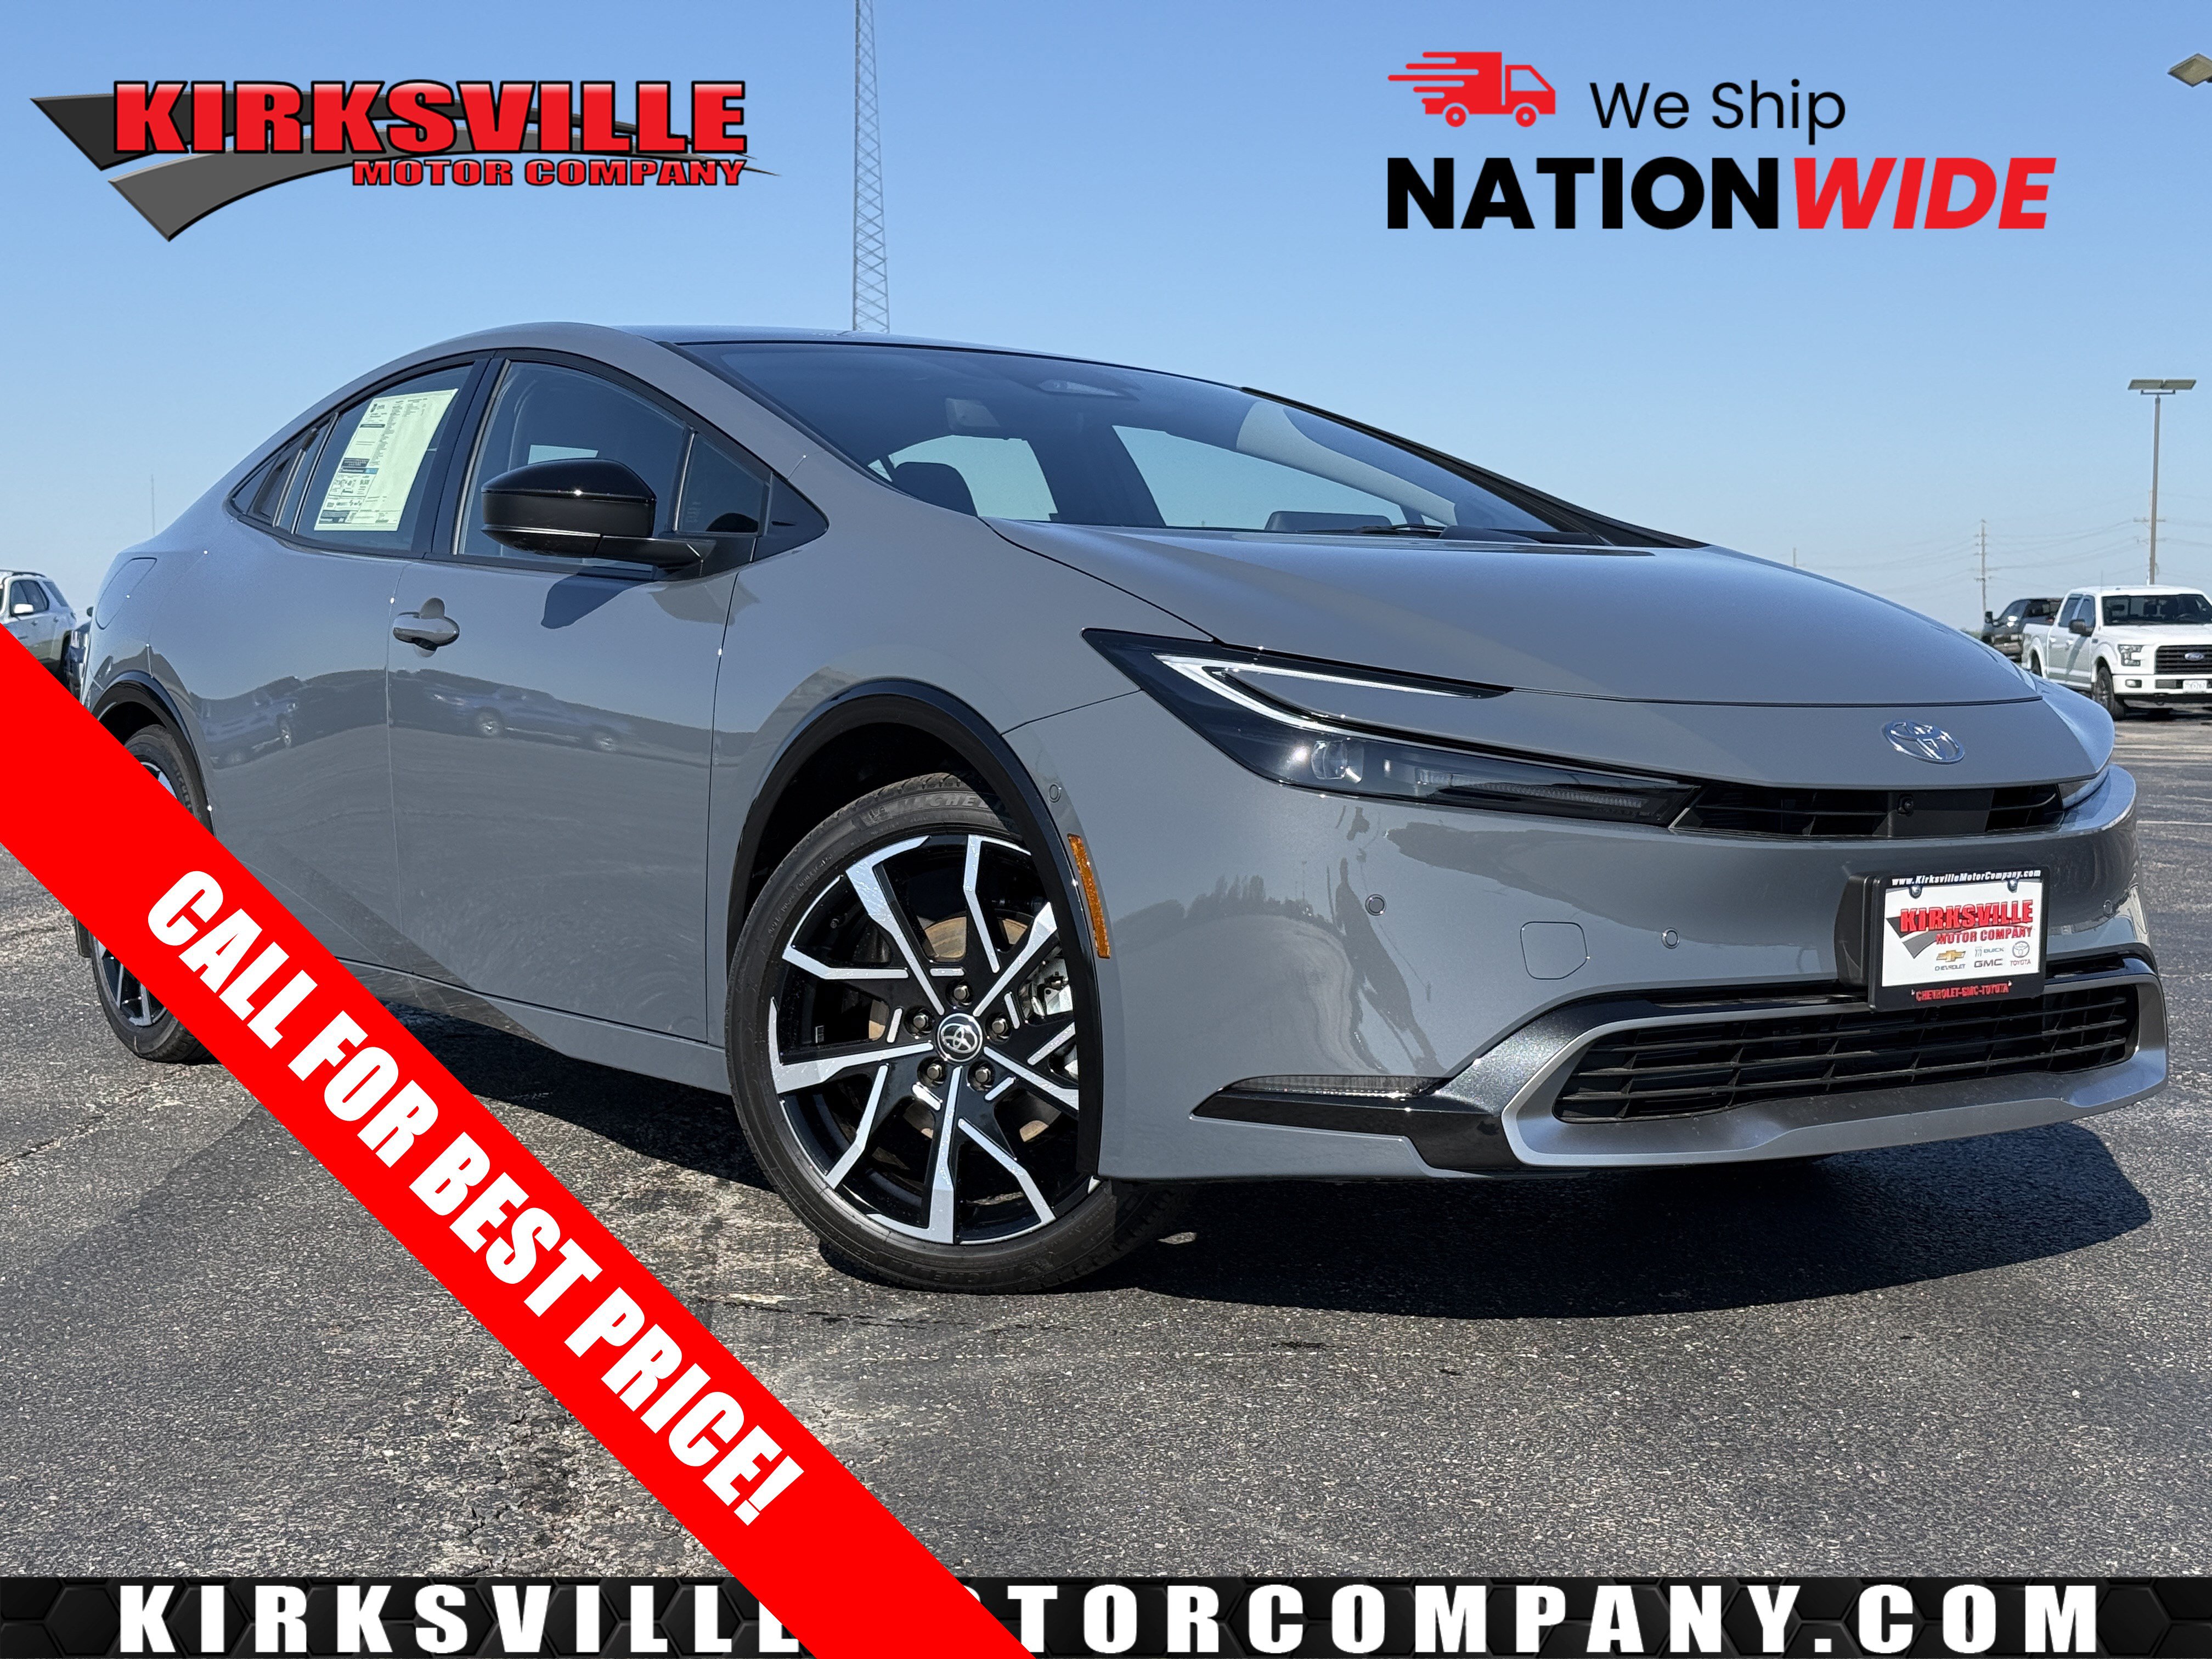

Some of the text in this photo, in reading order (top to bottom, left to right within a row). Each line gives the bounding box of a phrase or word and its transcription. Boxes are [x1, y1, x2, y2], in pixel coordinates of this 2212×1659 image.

[1892, 870, 2041, 886] www.KirksvilleMotorCompany.com
[1900, 899, 2033, 932] KIRKSVILLE
[1936, 926, 2033, 945] MOTOR COMPANY
[1974, 958, 2004, 968] GMC
